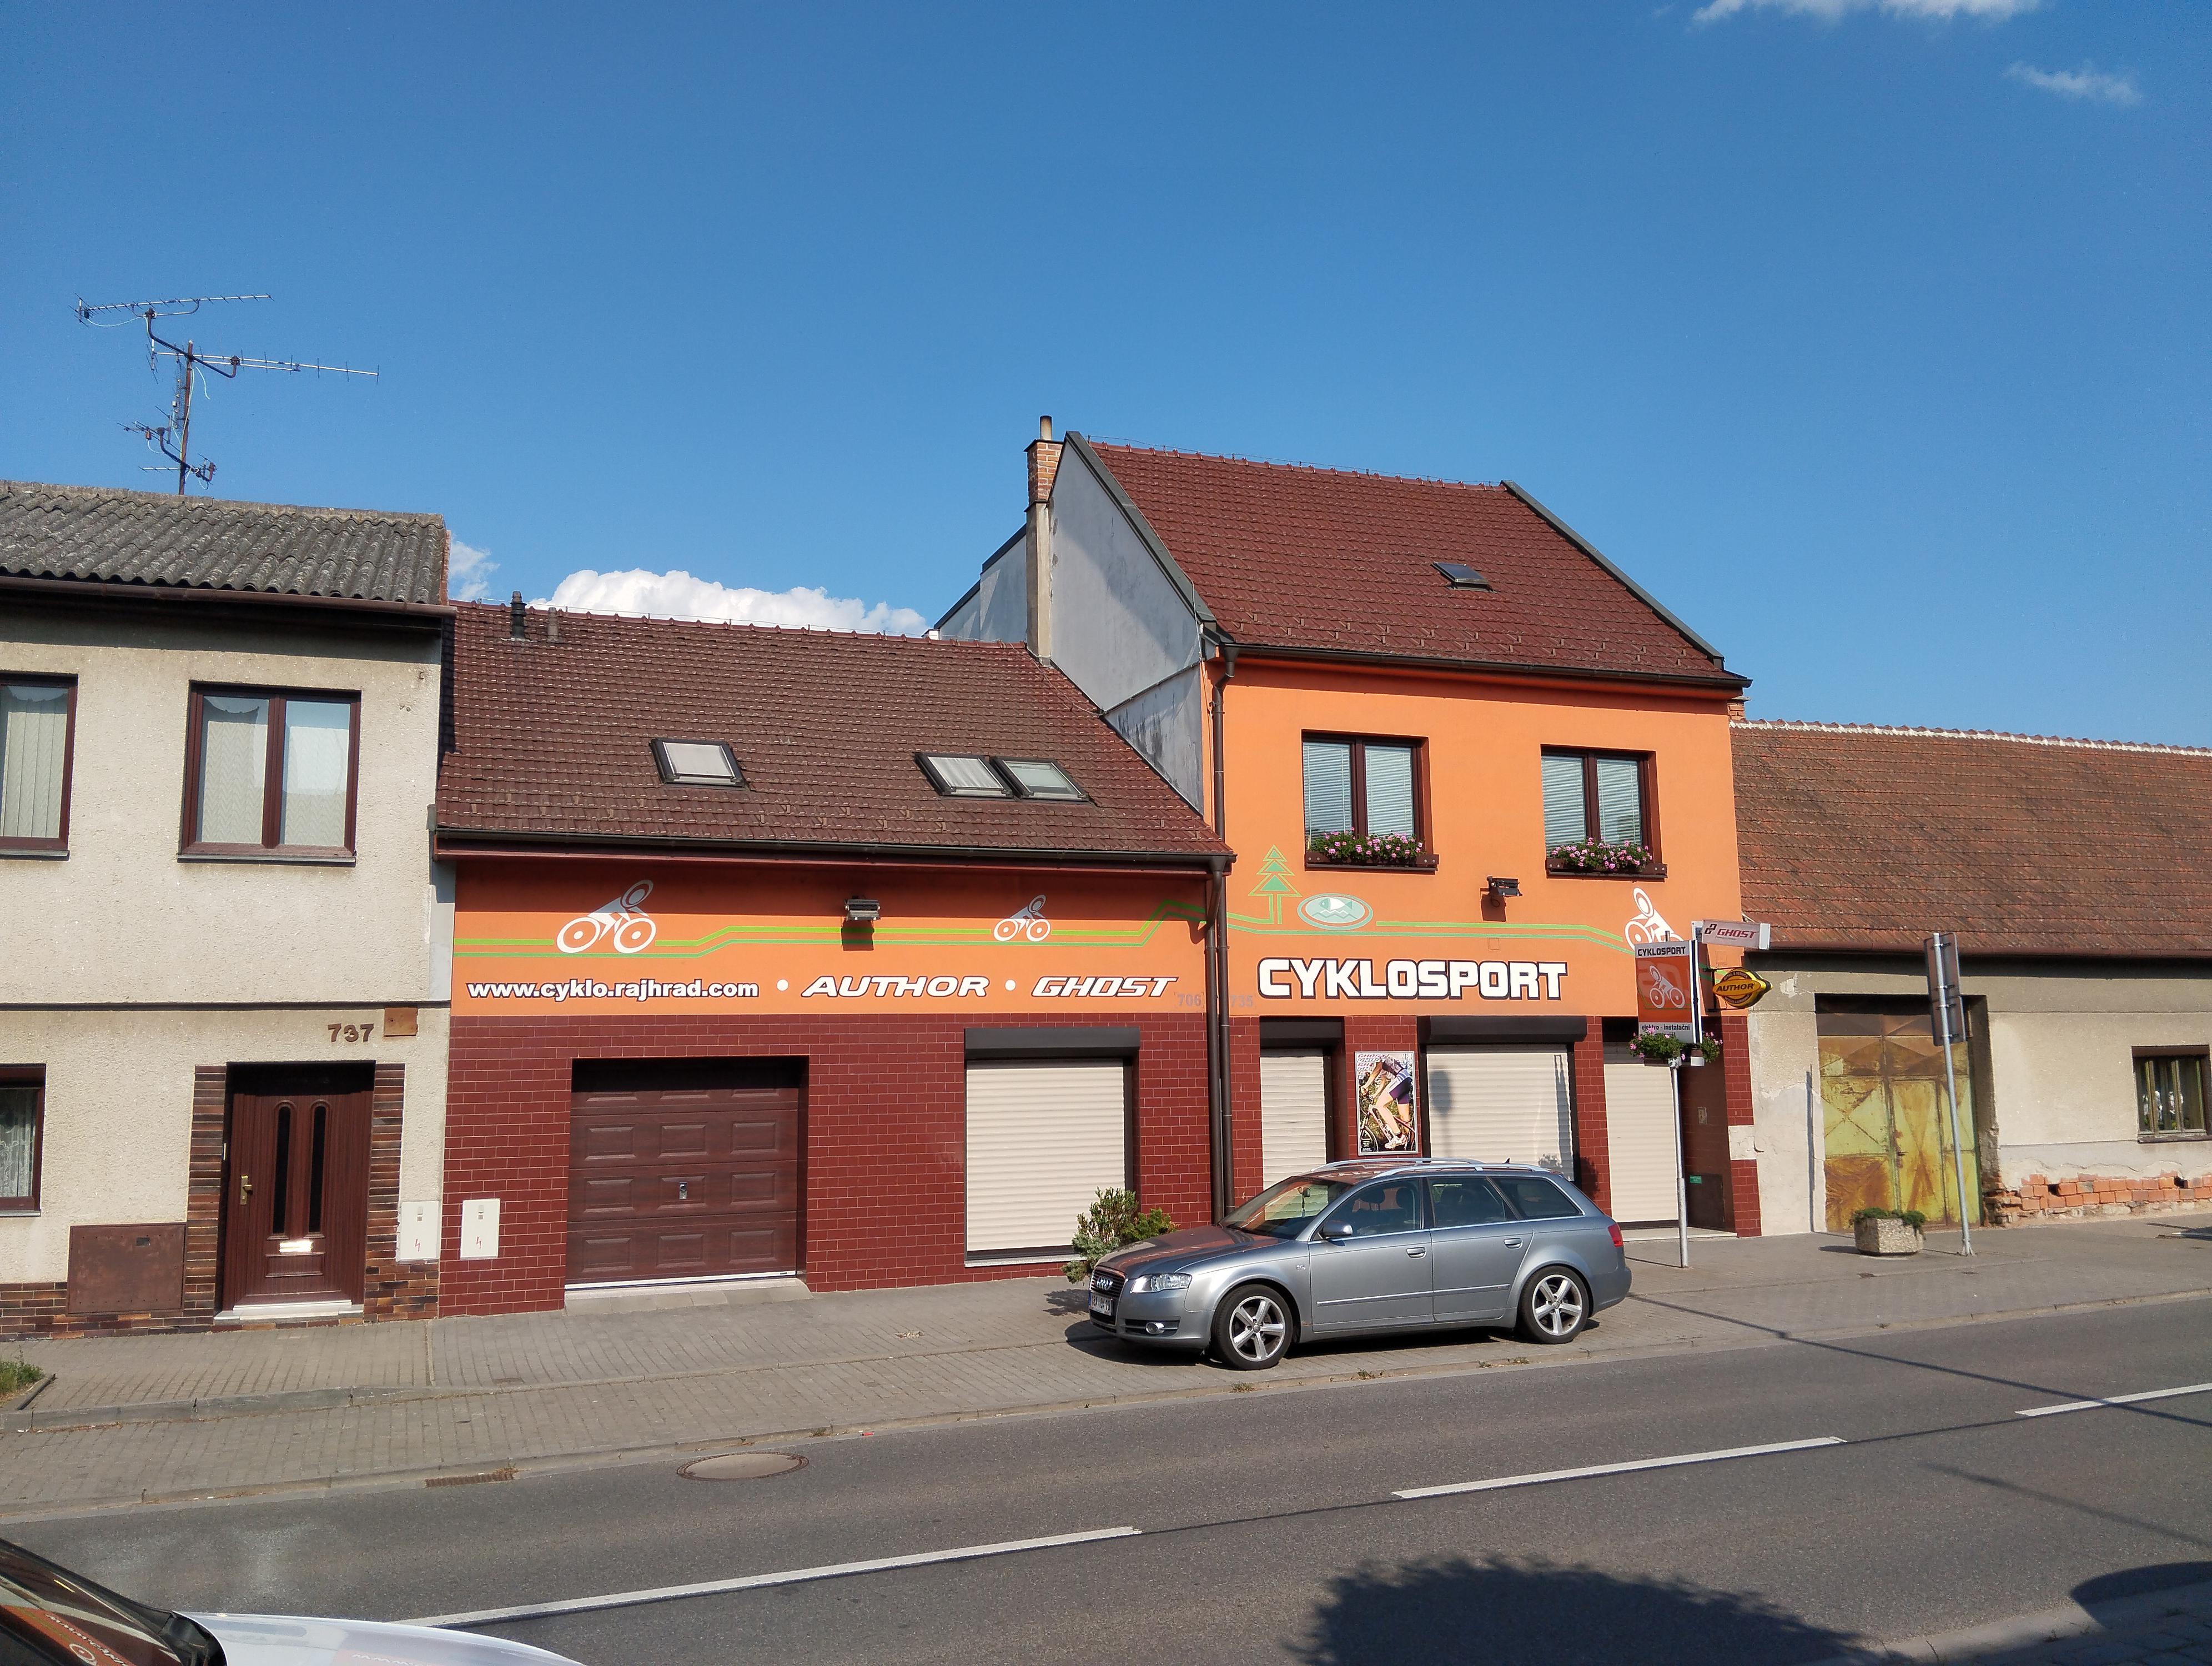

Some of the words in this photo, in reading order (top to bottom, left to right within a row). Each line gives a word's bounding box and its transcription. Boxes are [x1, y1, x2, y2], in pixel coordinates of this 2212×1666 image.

[1717, 929, 1757, 939] GHOST
[1637, 946, 1686, 956] CYKLOSPORT
[1257, 957, 1567, 1001] CYKLOSPORT
[466, 978, 759, 1002] www.cyklo.rajhrad.com
[800, 975, 991, 998] AUTHOR
[1031, 976, 1179, 998] GHOST
[1716, 983, 1754, 992] AUTHOR
[1177, 993, 1202, 1007] 706
[1229, 995, 1254, 1007] 735
[328, 1023, 374, 1042] 737
